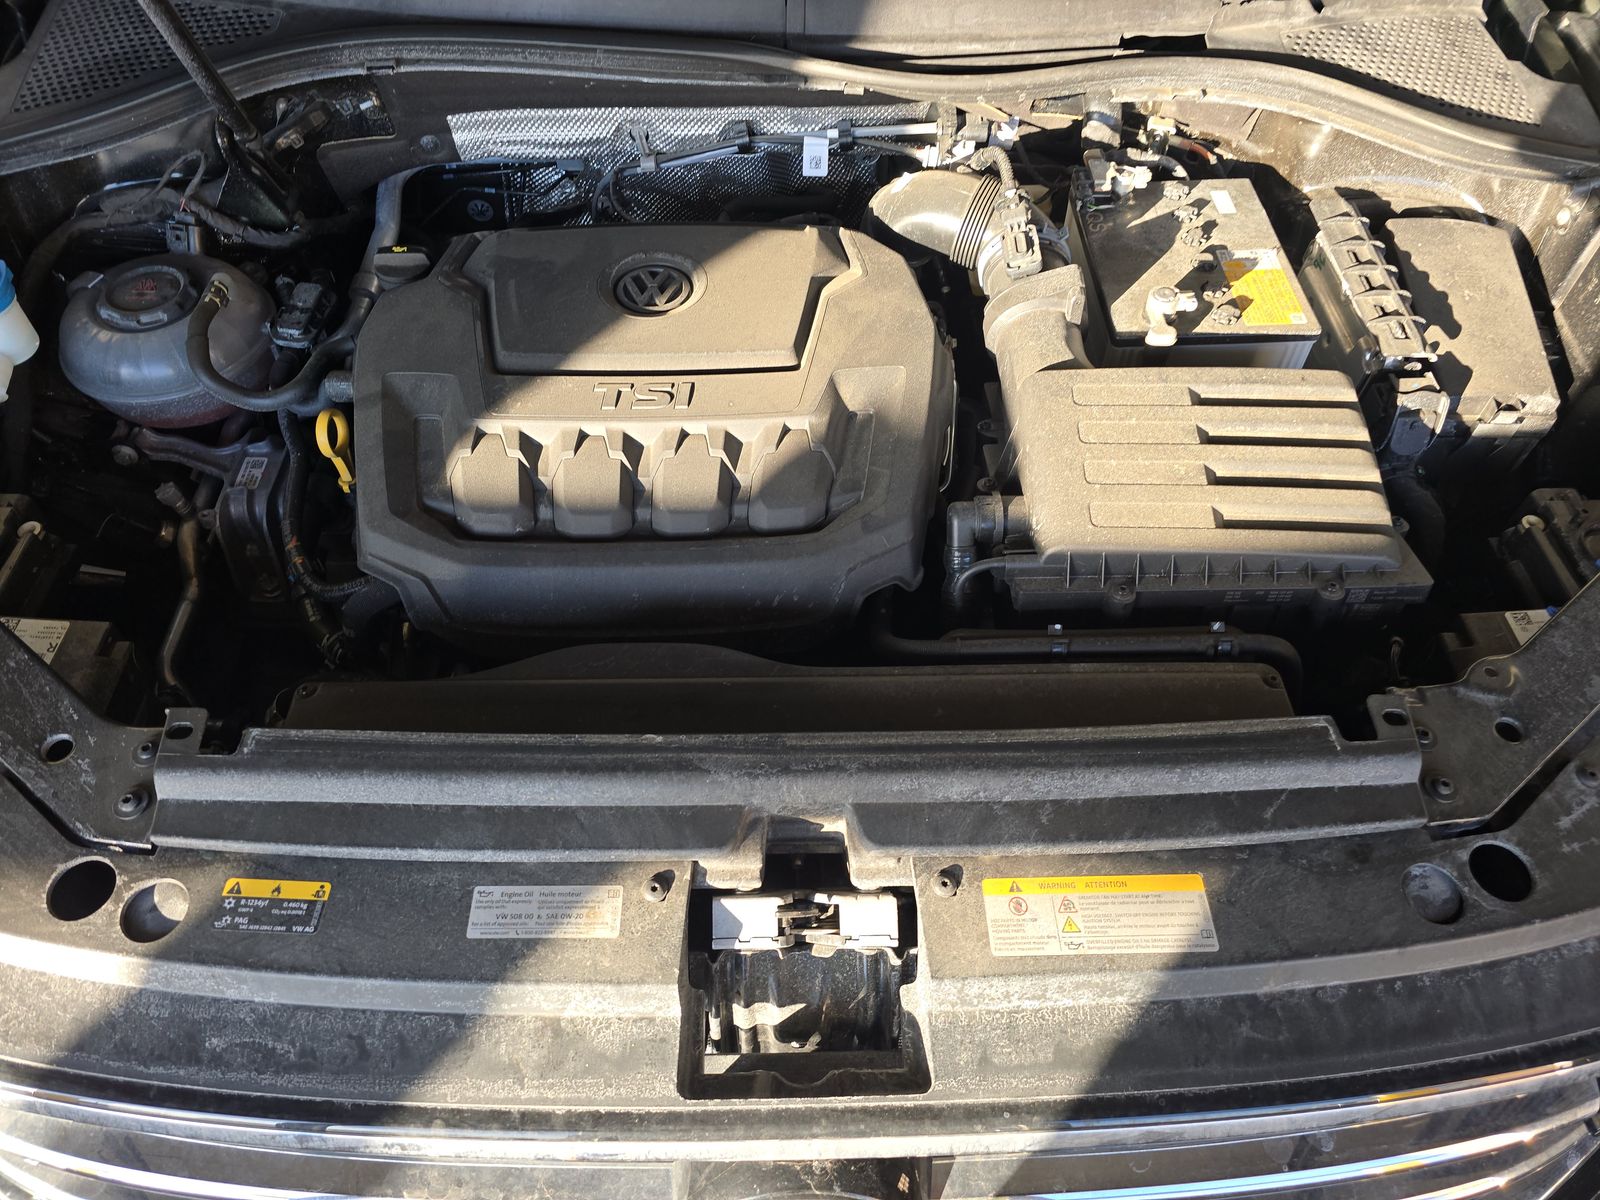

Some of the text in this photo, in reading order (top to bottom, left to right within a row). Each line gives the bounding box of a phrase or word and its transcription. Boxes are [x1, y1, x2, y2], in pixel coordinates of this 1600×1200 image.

[593, 381, 695, 410] TSI
[1039, 881, 1076, 889] WARNING
[501, 891, 523, 899] Engine
[240, 899, 269, 908] R-1234yf
[300, 902, 308, 910] kg
[234, 916, 249, 924] PAG
